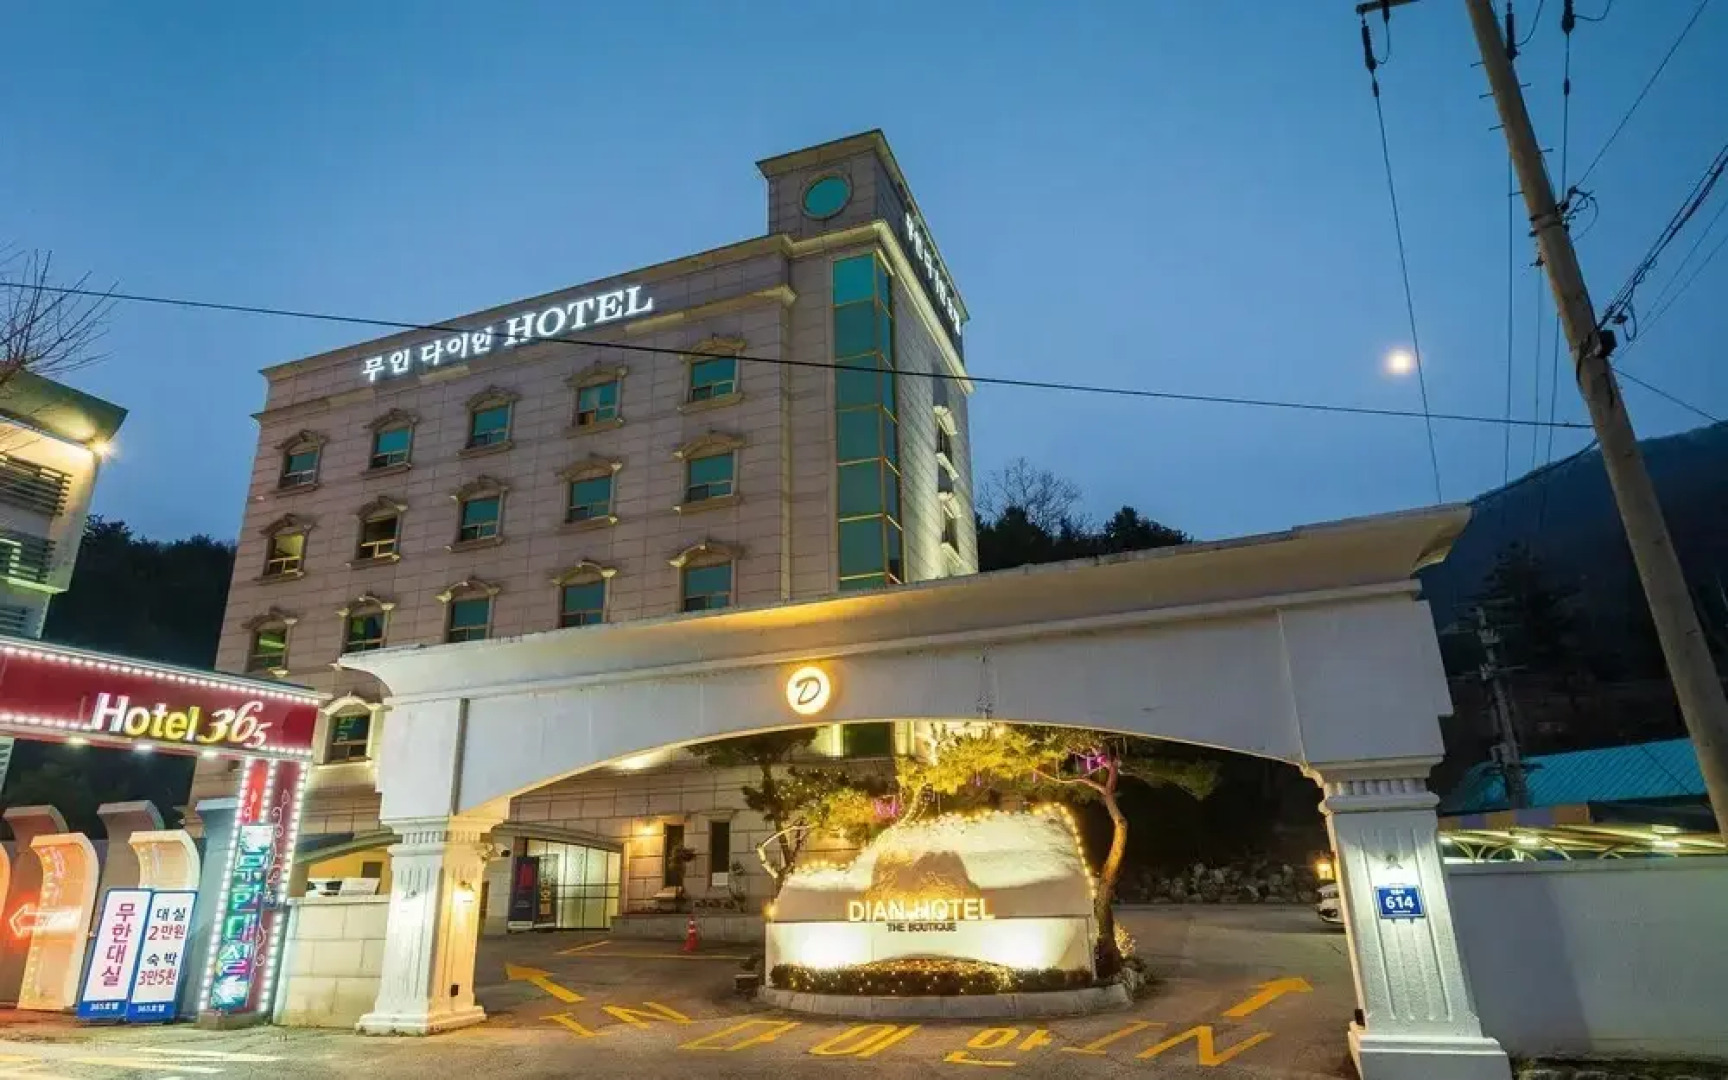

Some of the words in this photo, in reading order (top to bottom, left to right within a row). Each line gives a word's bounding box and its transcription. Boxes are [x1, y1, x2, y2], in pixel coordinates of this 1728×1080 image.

[362, 348, 411, 382] 무인
[503, 284, 655, 347] HOTEL
[85, 692, 200, 743] Hotel
[197, 700, 272, 748] 365
[848, 898, 905, 922] DIAN
[915, 898, 995, 921] HOTEL
[1385, 896, 1415, 909] 614
[156, 907, 186, 922] 대실
[148, 924, 185, 941] 2만원
[886, 922, 905, 932] THE
[101, 903, 136, 986] 무한대실
[146, 952, 178, 967] 숙박
